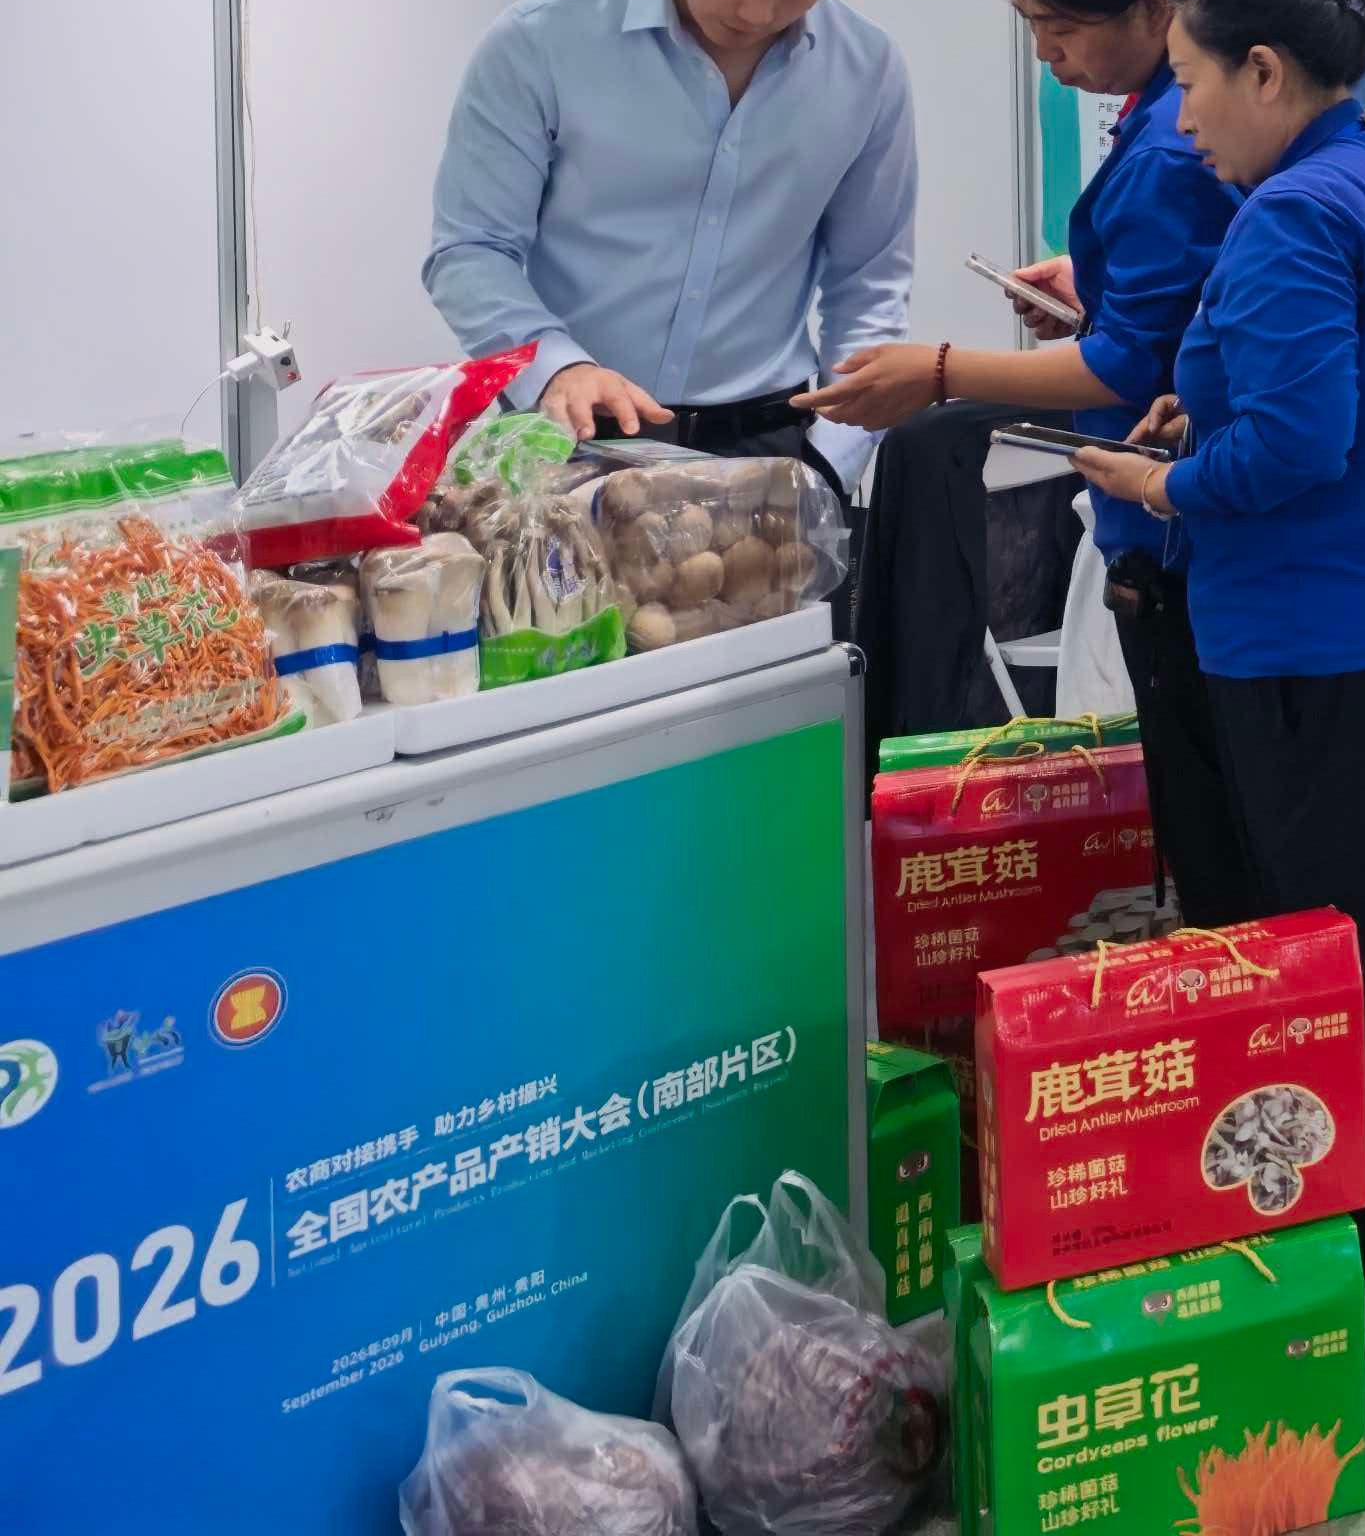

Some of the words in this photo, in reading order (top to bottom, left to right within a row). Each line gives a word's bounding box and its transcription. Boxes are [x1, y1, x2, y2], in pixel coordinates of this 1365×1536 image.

[74, 591, 240, 681] 虫草花
[896, 839, 1038, 897] 鹿茸菇
[916, 944, 981, 966] 山珍好礼
[1024, 1037, 1197, 1123] 鹿茸菇
[286, 1125, 420, 1193] 农商对接携手
[435, 1073, 557, 1137] 助力乡村振兴
[1039, 1119, 1077, 1142] Dried
[1079, 1111, 1122, 1134] Antler
[1125, 1095, 1200, 1124] Mushroom
[1047, 1154, 1127, 1188] 珍稀菌菇
[1050, 1175, 1129, 1209] 山珍好礼
[0, 1198, 260, 1397] 2026
[282, 1369, 364, 1414] September
[369, 1350, 404, 1376] 2026
[551, 1271, 588, 1295] China
[331, 1327, 413, 1374] 2026年09月
[1037, 1363, 1200, 1449] 虫草花
[1156, 1415, 1219, 1442] flower
[1041, 1494, 1120, 1532] 山珍好礼
